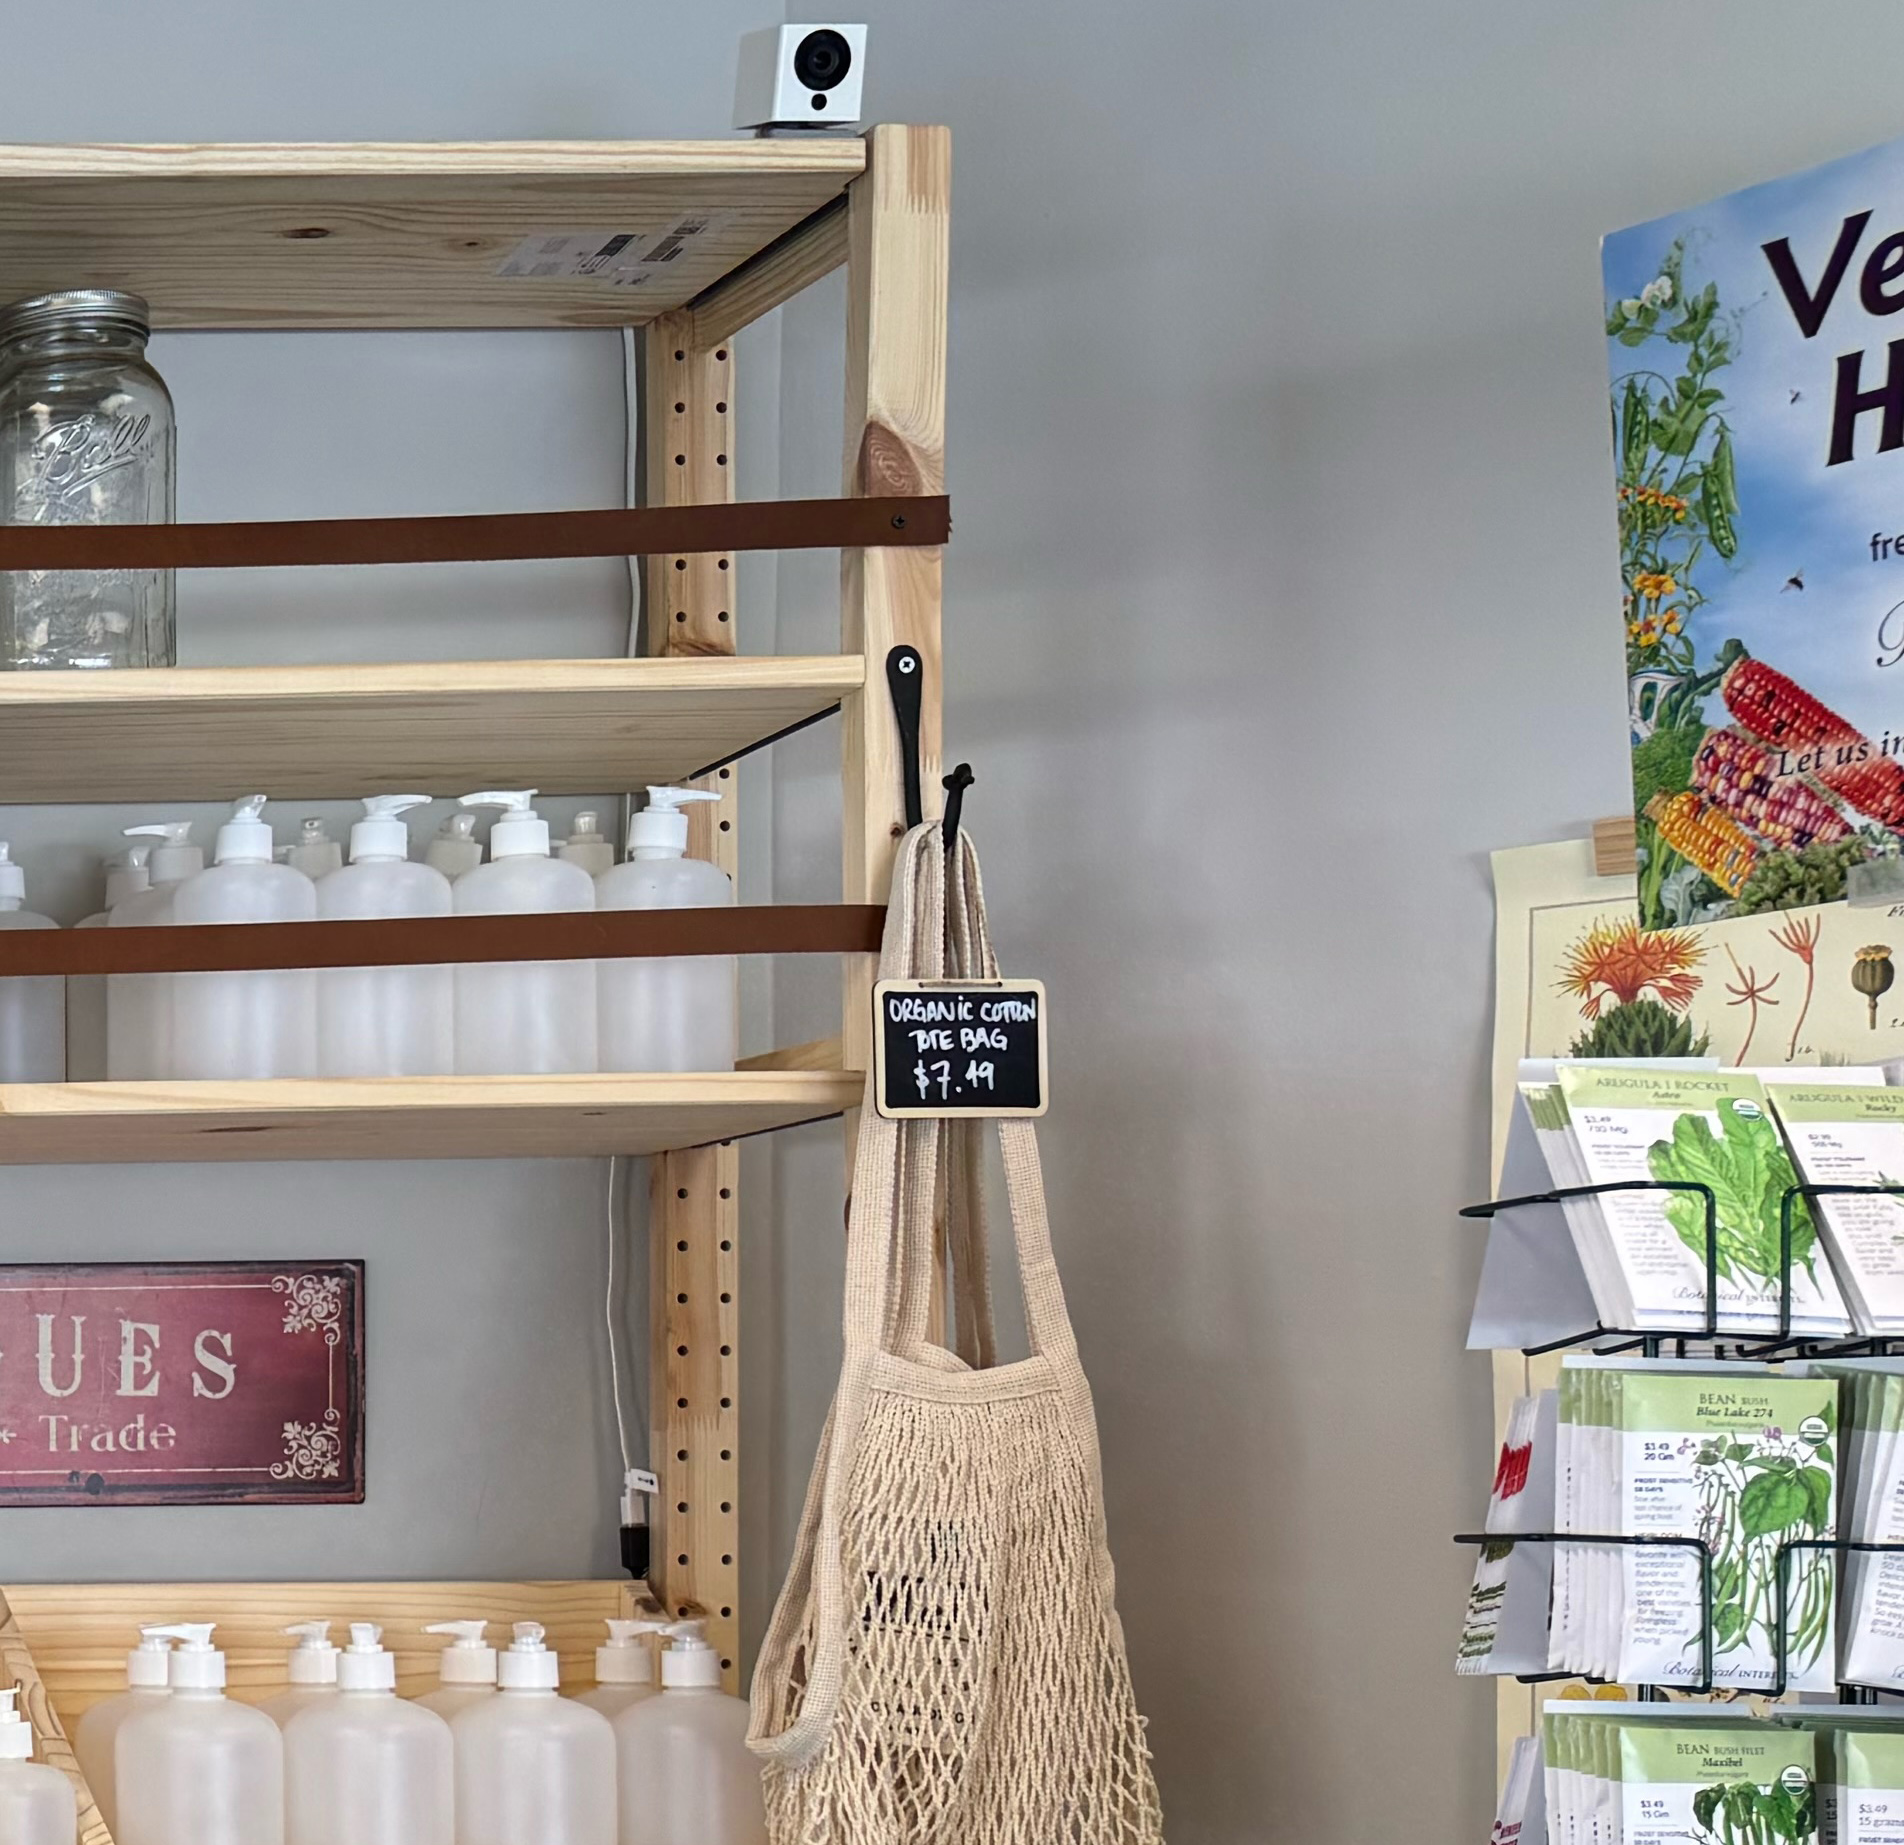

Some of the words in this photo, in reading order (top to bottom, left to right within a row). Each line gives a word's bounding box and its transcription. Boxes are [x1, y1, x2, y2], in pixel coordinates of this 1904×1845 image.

[32, 413, 151, 498] Ball
[1776, 744, 1826, 778] Let
[1835, 741, 1870, 766] us
[908, 1028, 955, 1053] TOTE
[960, 1027, 1008, 1053] BAG
[913, 1059, 995, 1101] $7.49
[1675, 1080, 1730, 1092] ROCKET
[1697, 1407, 1721, 1418] Blue
[1725, 1408, 1750, 1418] Lake
[1753, 1408, 1773, 1418] 274
[1699, 1394, 1736, 1405] BEAN
[38, 1413, 177, 1453] Trade
[1676, 1744, 1709, 1755] BEAN
